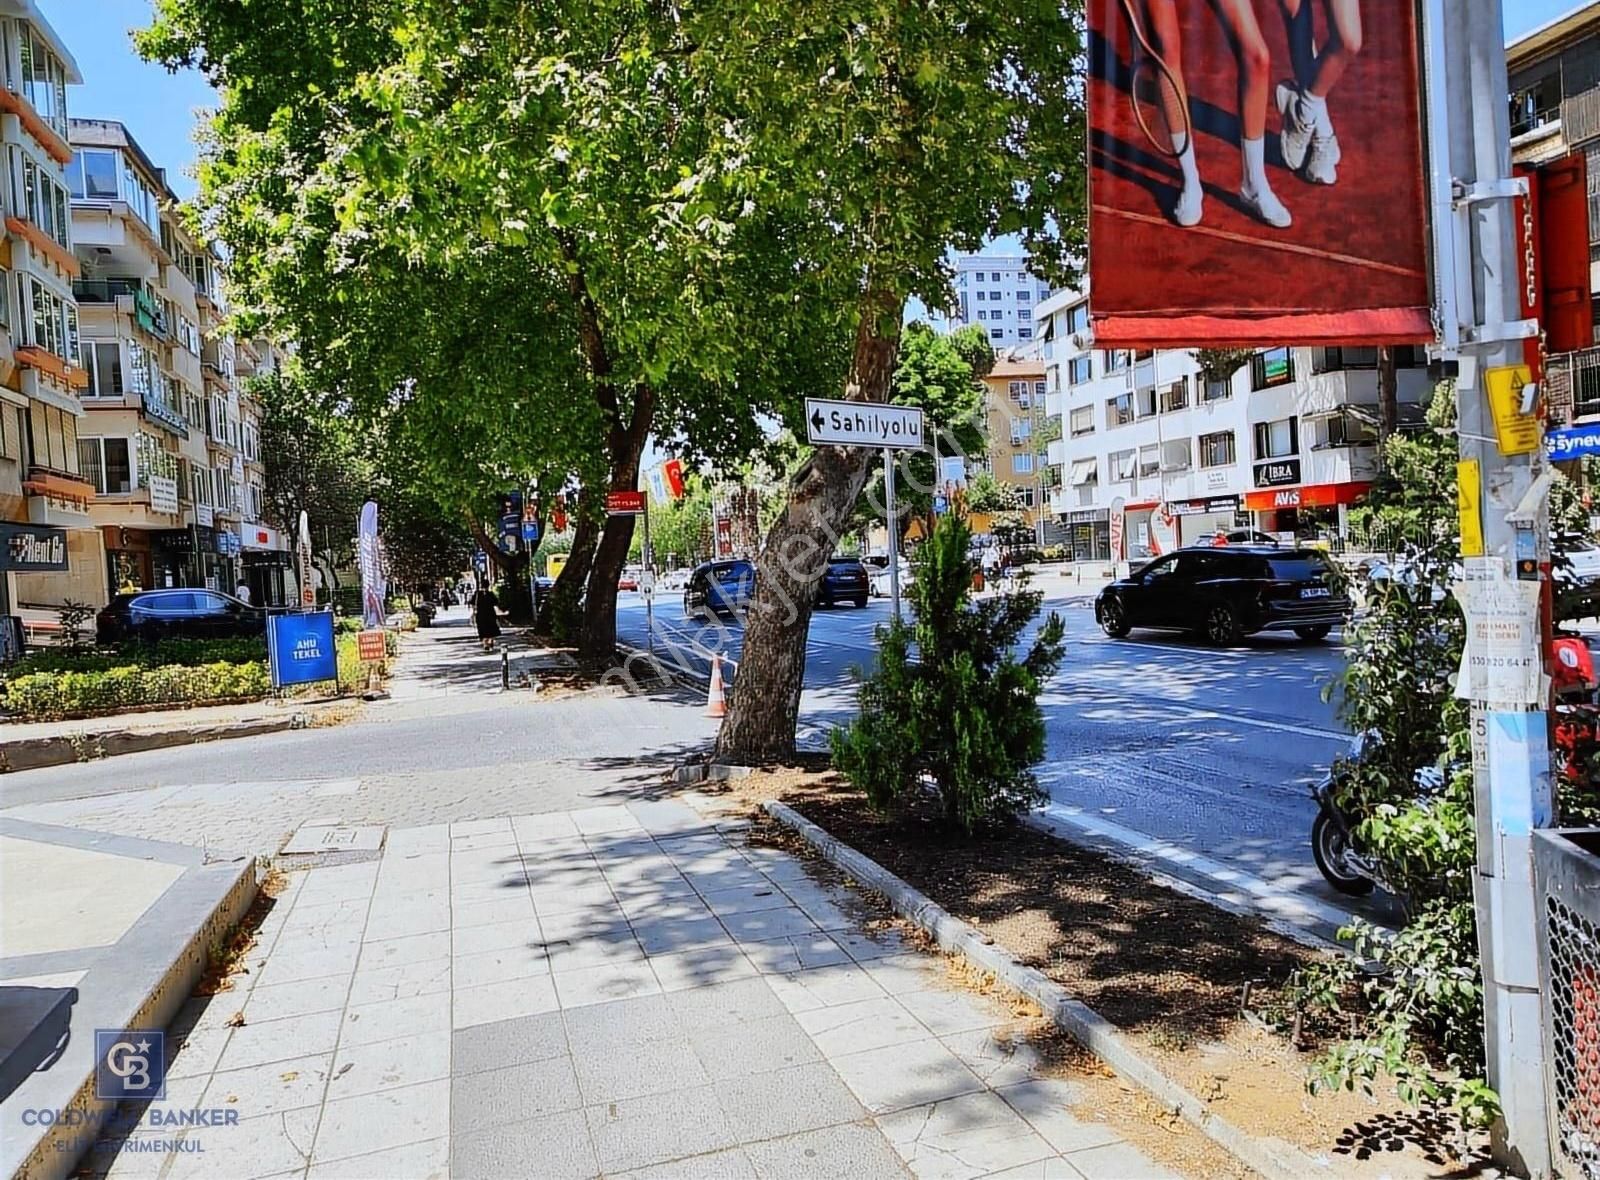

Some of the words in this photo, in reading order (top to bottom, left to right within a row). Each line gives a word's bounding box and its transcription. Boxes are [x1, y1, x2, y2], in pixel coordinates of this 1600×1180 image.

[831, 410, 919, 439] Sahilyolu
[27, 533, 50, 563] Rent
[52, 535, 64, 564] Go
[296, 638, 317, 649] AHU
[292, 648, 322, 660] TEKEL
